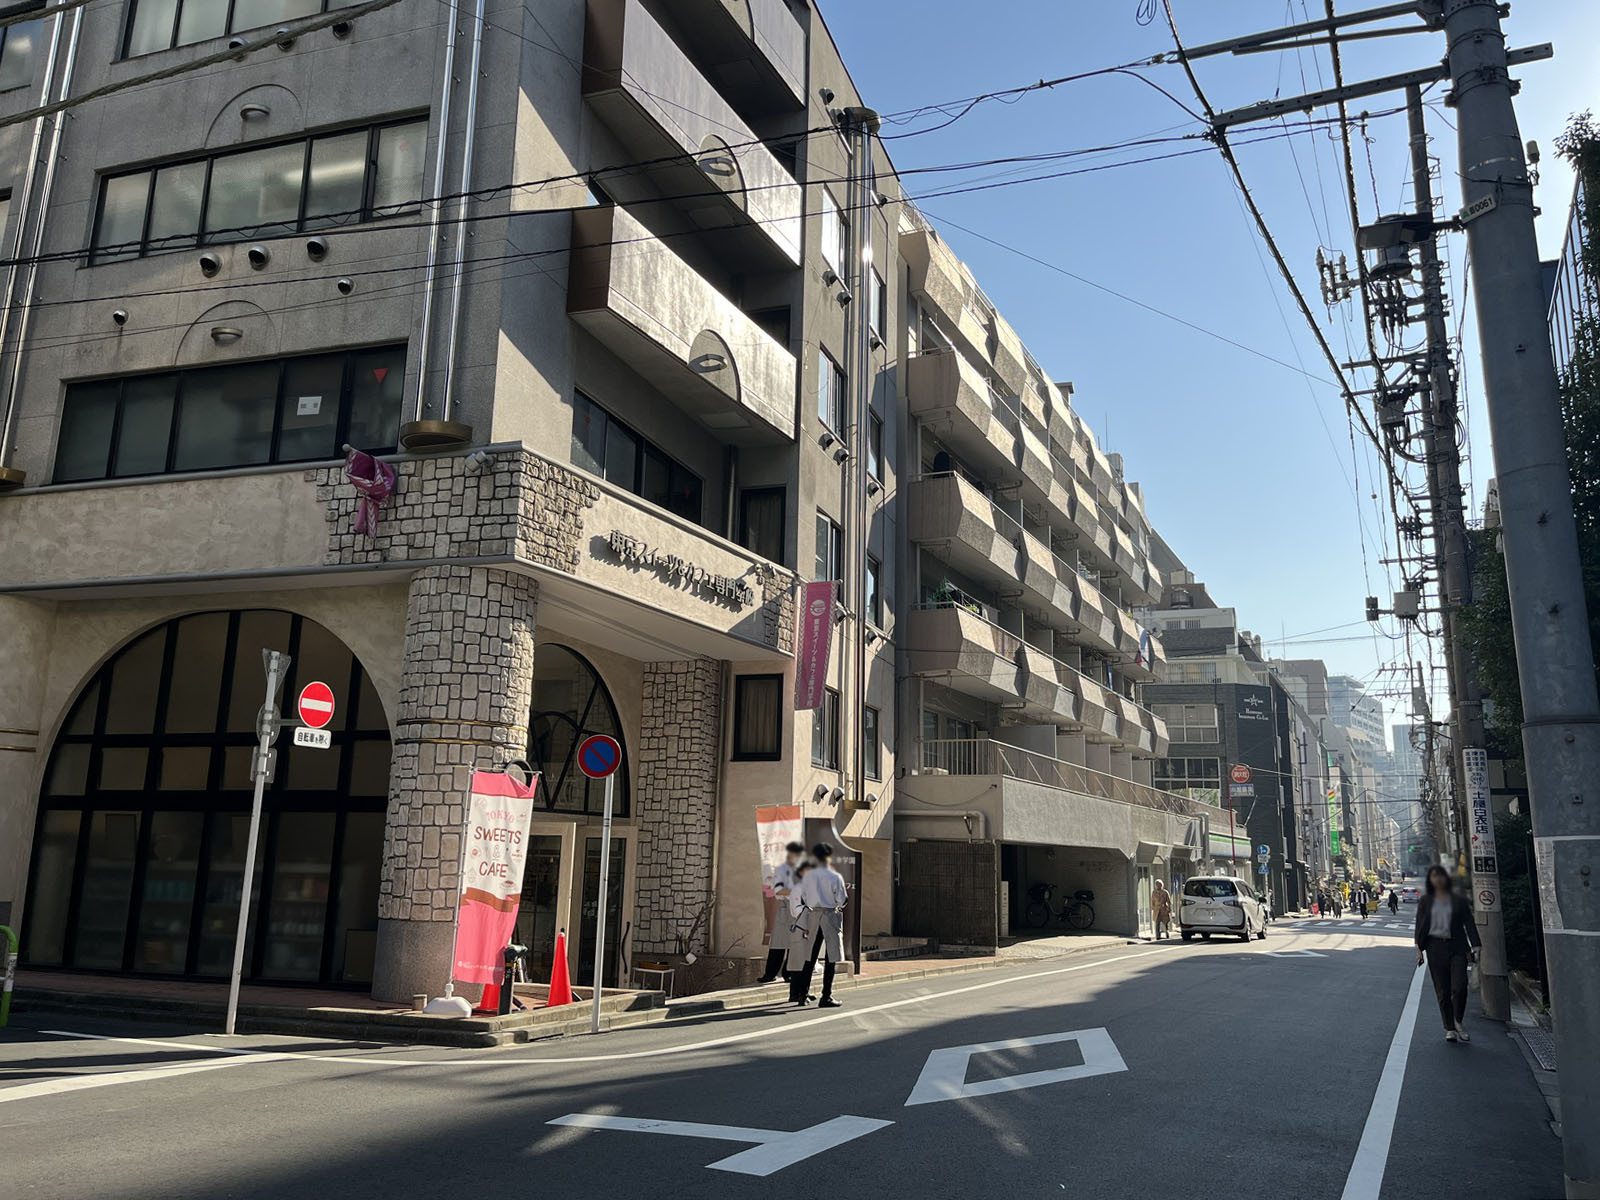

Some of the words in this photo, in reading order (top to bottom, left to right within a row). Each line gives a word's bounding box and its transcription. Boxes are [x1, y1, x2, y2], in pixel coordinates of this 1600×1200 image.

[297, 731, 328, 745] 自転車を除く
[486, 809, 515, 824] TOKYO
[474, 826, 522, 845] SWEETS
[479, 861, 509, 878] CAFE
